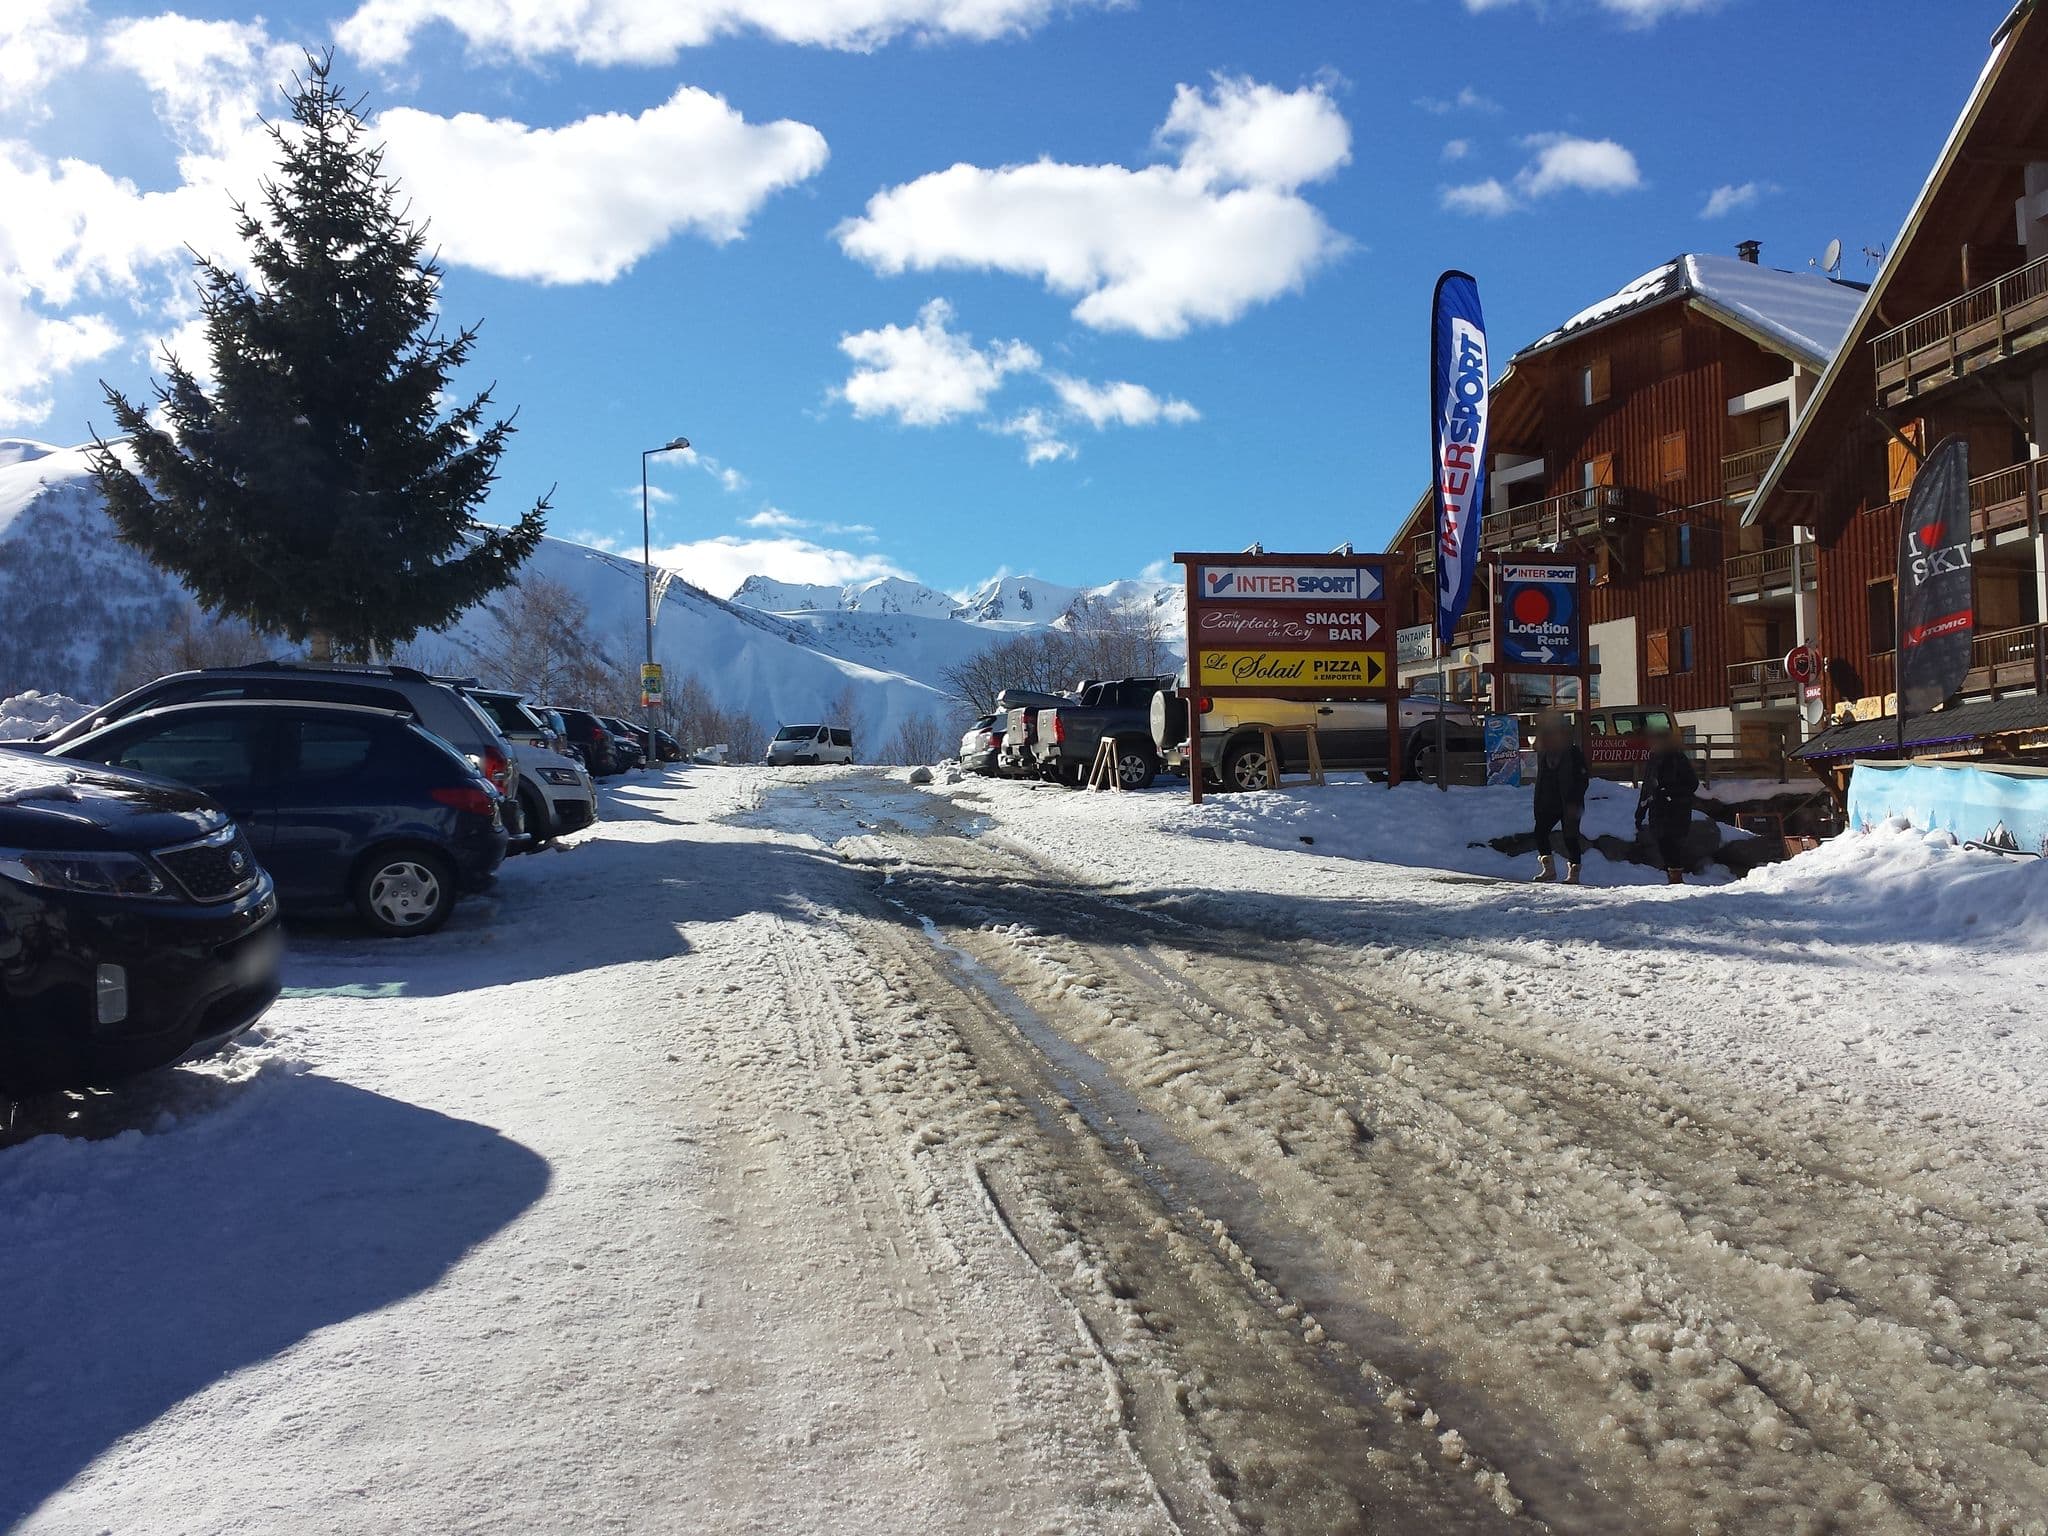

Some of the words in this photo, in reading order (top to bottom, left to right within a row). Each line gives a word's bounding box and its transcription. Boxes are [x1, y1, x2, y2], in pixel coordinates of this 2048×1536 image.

[1441, 333, 1485, 558] INTERSPORT
[1908, 531, 1922, 557] I
[1911, 543, 1972, 586] SKI
[1305, 612, 1362, 625] SNACK
[1508, 619, 1569, 634] Location
[1329, 628, 1362, 641] BAR
[1919, 617, 1967, 639] ATOMIC
[1537, 635, 1569, 645] Rent
[1203, 653, 1229, 670] Le
[1313, 660, 1362, 672] PIZZA
